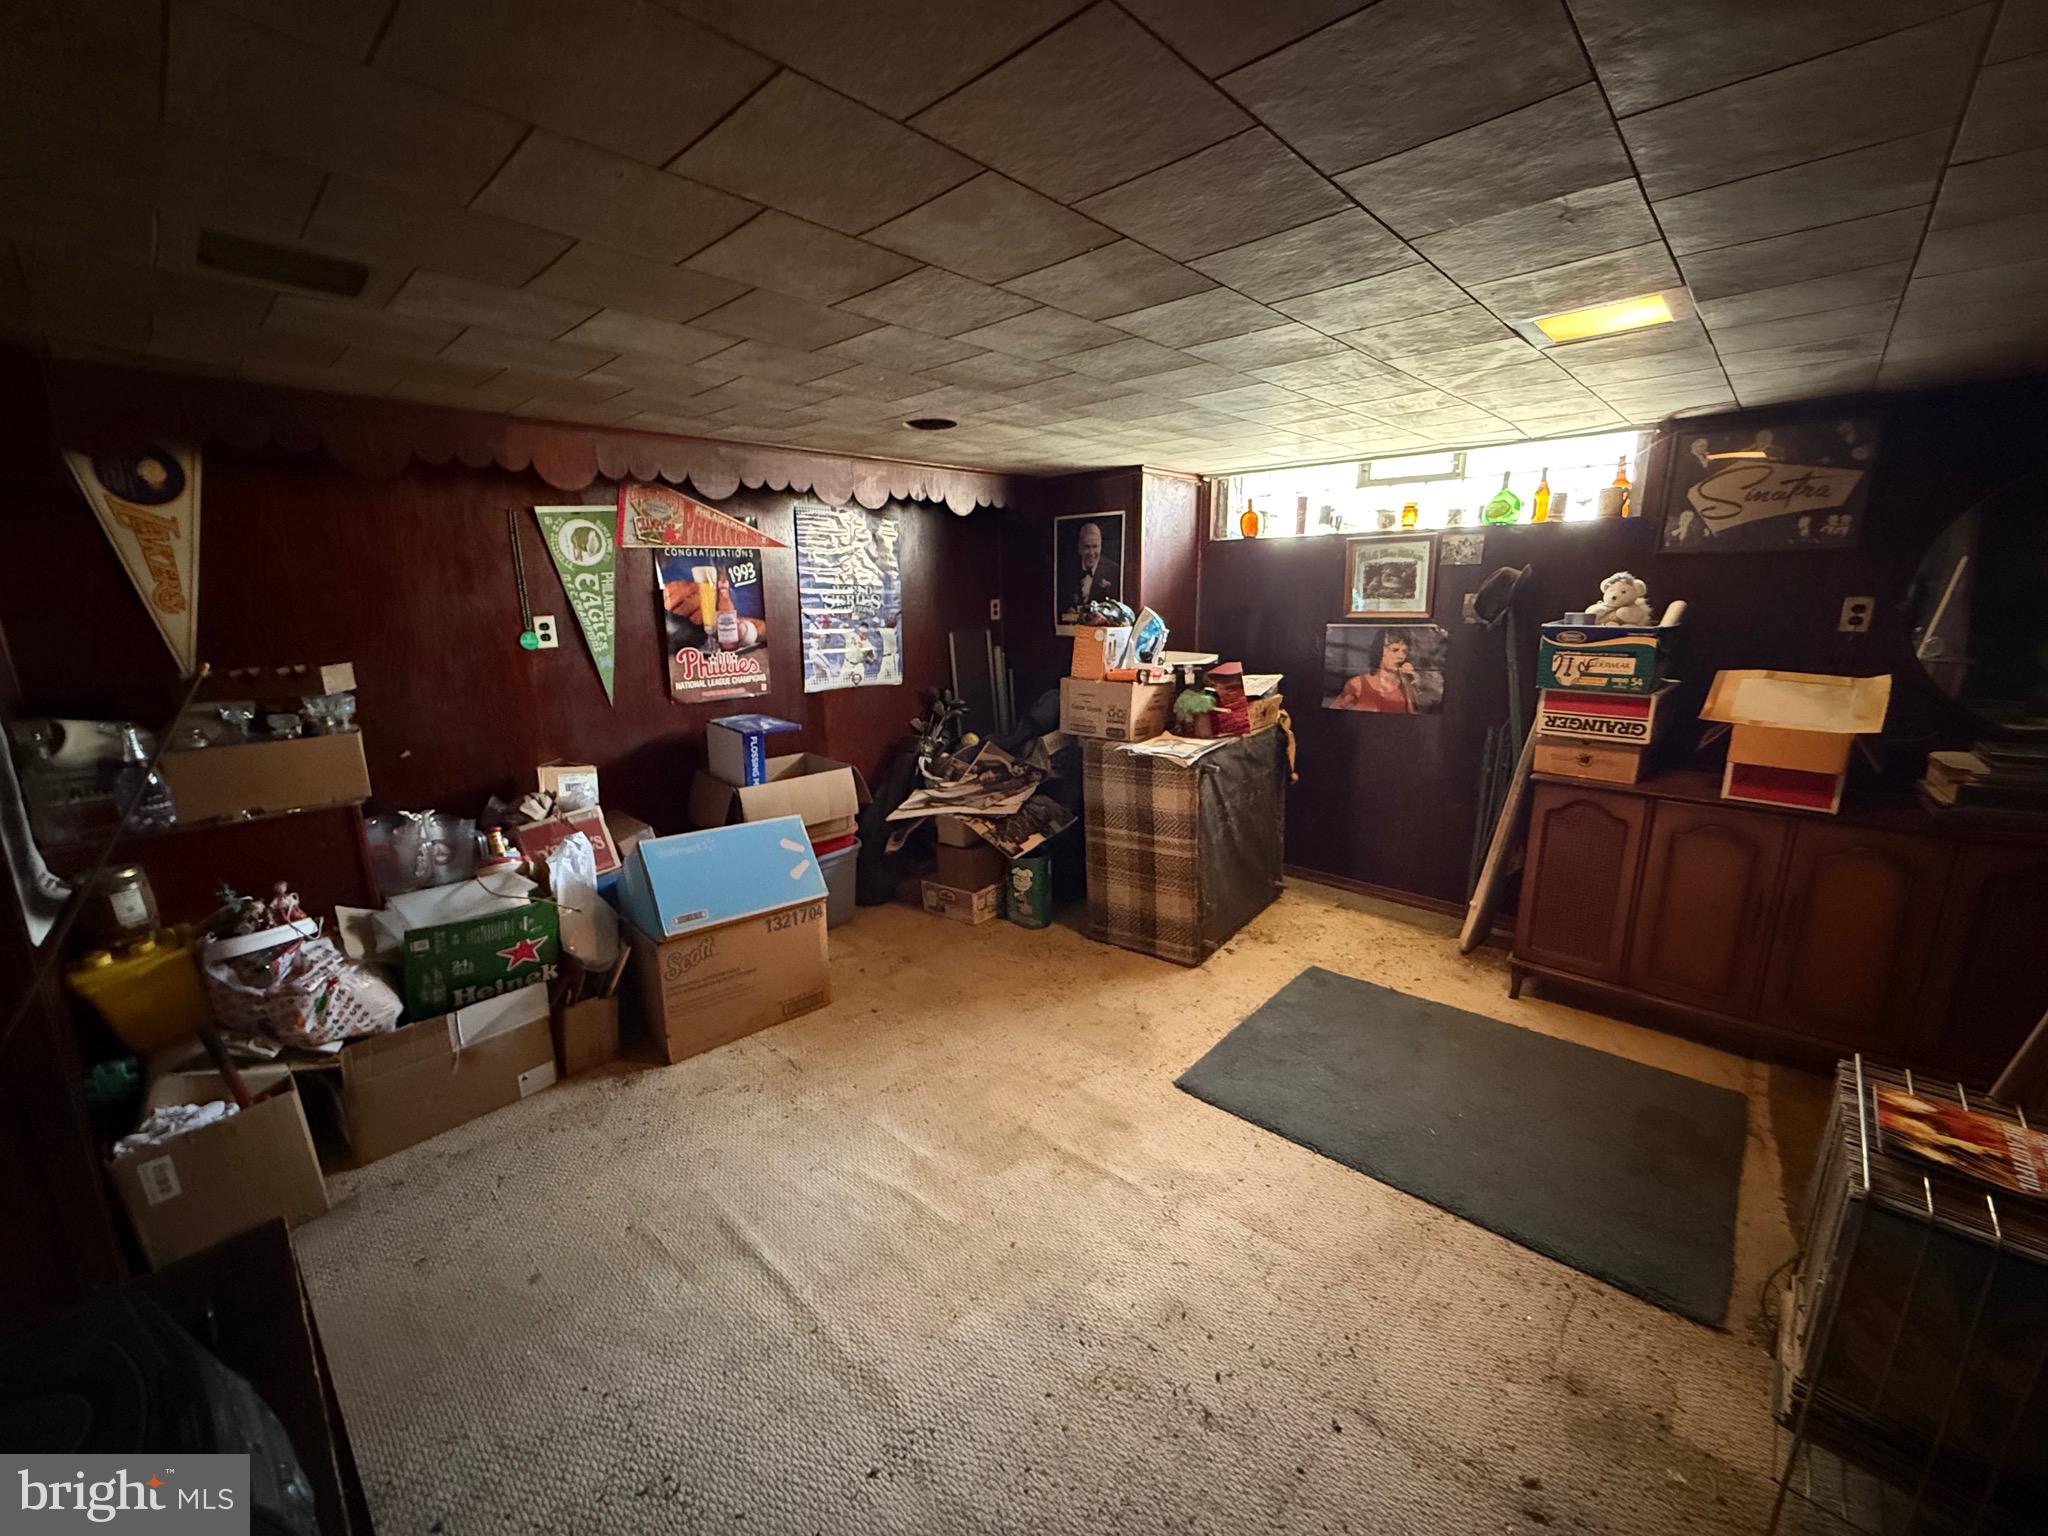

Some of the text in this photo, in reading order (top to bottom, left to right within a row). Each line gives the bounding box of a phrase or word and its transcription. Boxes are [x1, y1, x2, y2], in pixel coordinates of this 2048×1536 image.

[1698, 465, 1842, 520] Sinatra
[664, 547, 754, 558] CONGRATULATIONS
[728, 562, 756, 583] 1993
[574, 572, 609, 652] EAGLES
[600, 571, 616, 636] PHILADELPHIA
[676, 647, 762, 680] Phillies
[675, 674, 767, 691] NATIONAL LEAGUE CHAMPIONS
[1545, 716, 1647, 736] GRAINGER
[750, 736, 760, 777] FLOSSING
[664, 935, 714, 981] Scott
